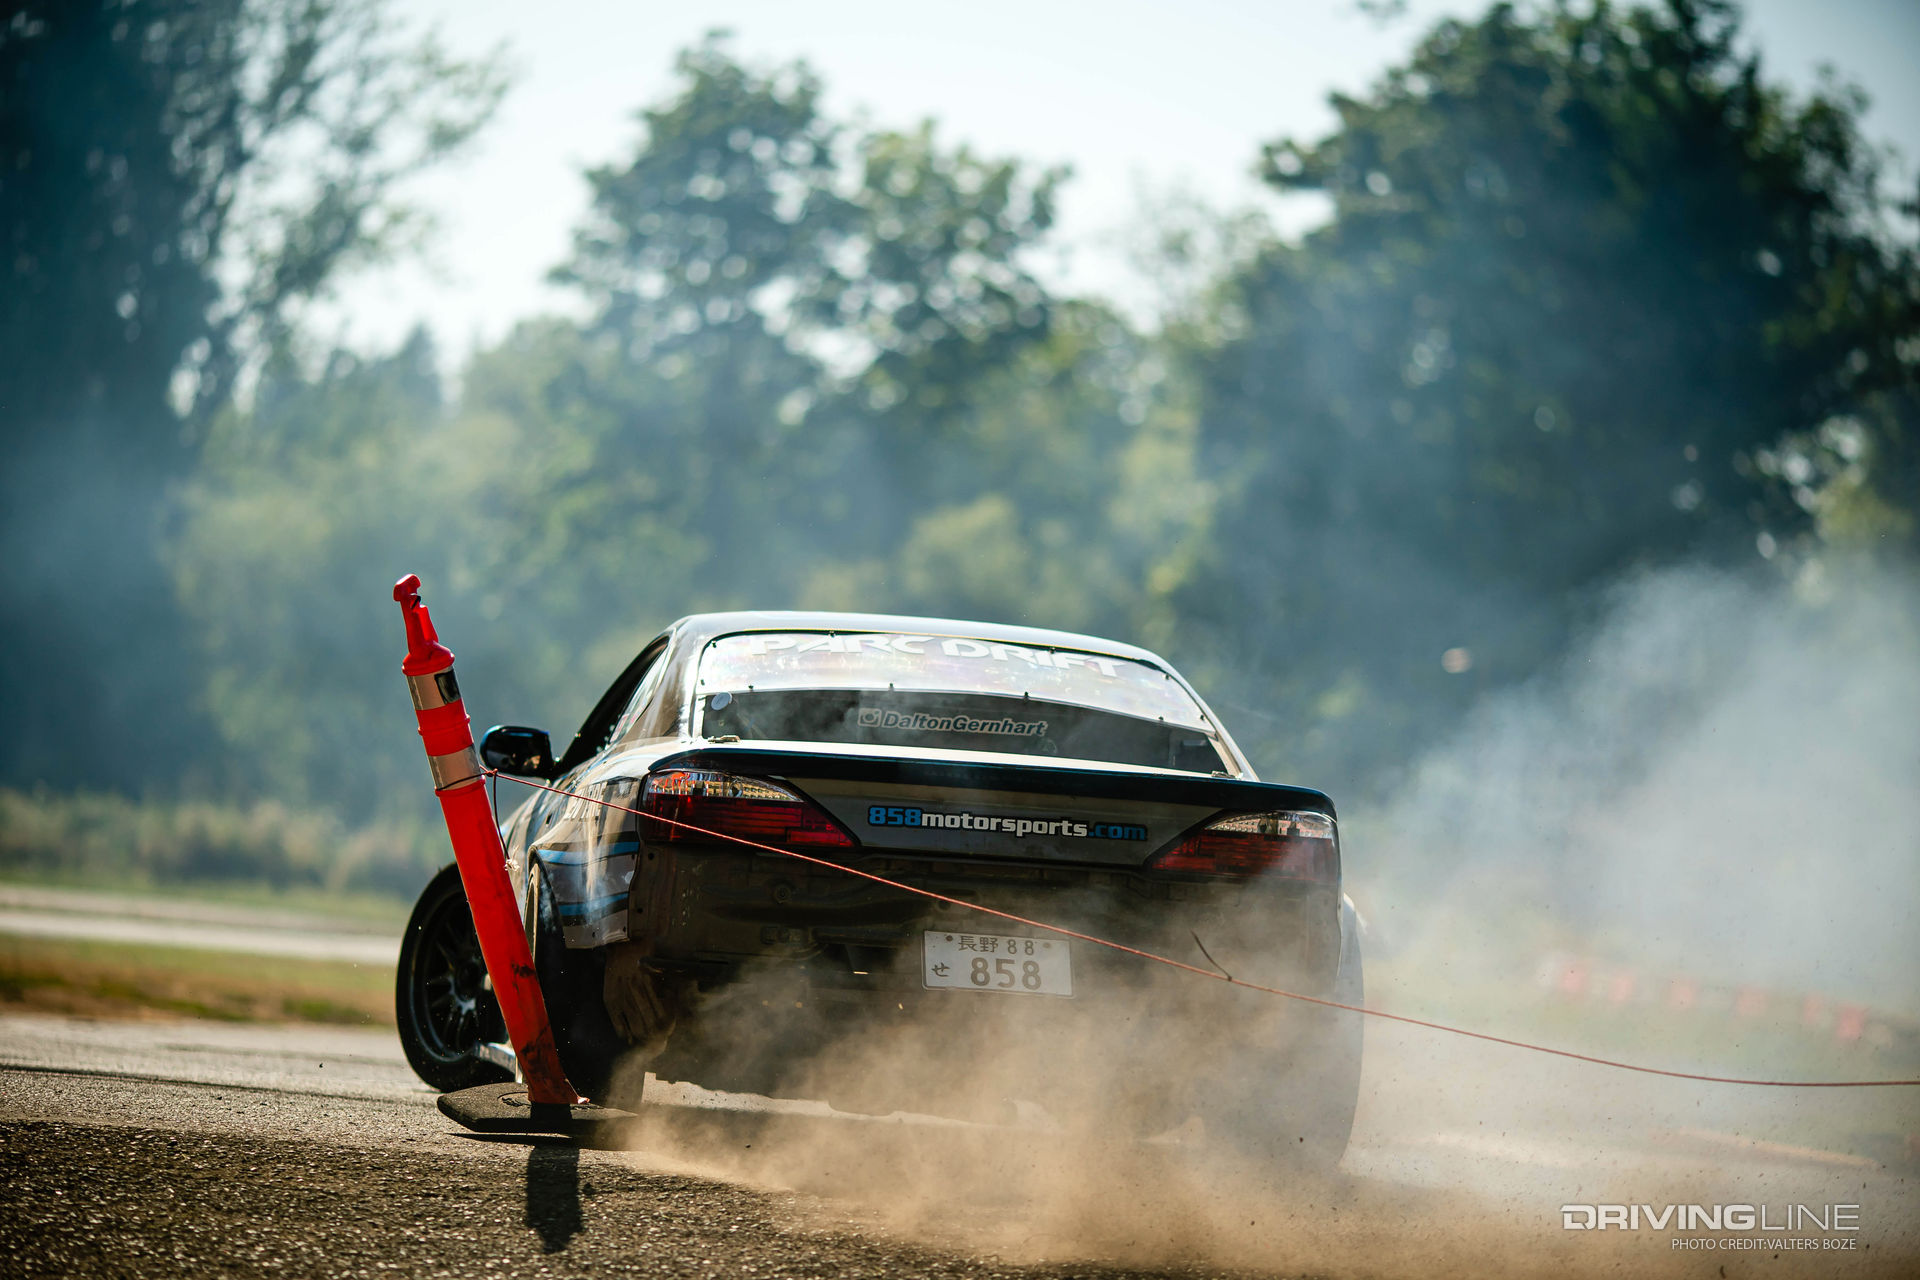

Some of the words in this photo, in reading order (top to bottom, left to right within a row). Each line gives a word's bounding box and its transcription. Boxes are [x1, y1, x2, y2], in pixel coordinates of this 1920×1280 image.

[750, 635, 935, 655] PARC
[941, 639, 1129, 677] DRIFT
[882, 712, 1048, 737] DaltonGernhart
[868, 806, 1147, 841] 858motorsports.com
[957, 935, 999, 953] 長野
[1007, 939, 1035, 956] 88
[931, 962, 950, 978] せ
[970, 957, 1042, 990] 858
